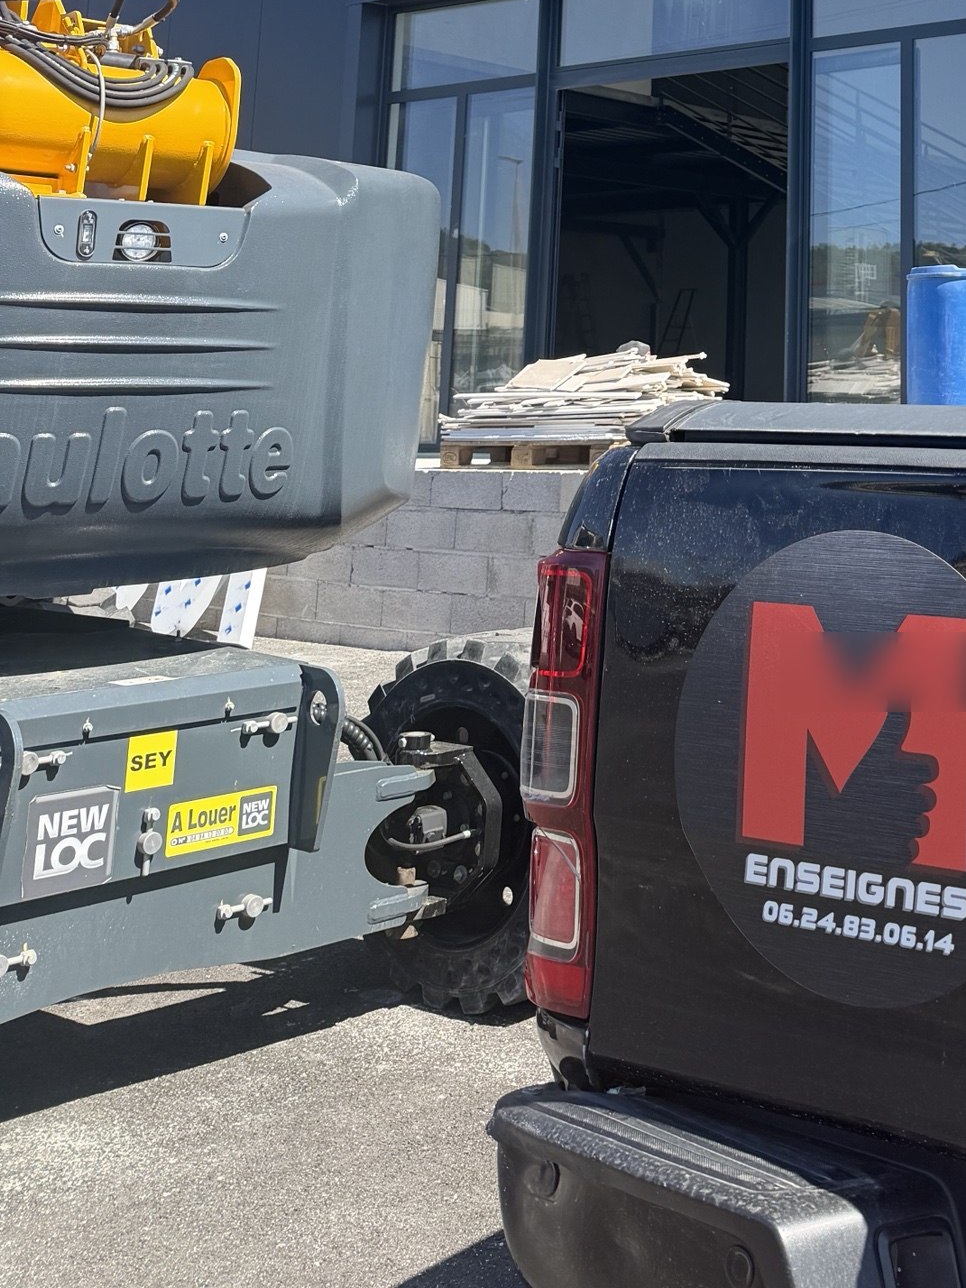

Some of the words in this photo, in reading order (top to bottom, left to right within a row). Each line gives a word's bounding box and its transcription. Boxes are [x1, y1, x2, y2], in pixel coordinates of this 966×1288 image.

[130, 749, 173, 772] SEY
[171, 811, 183, 834] A
[188, 804, 237, 830] Louer
[241, 810, 269, 830] LOC
[242, 798, 270, 814] NEW
[37, 803, 110, 841] NEW
[33, 832, 107, 880] LOC
[762, 900, 955, 956] 06.24.83.06.14
